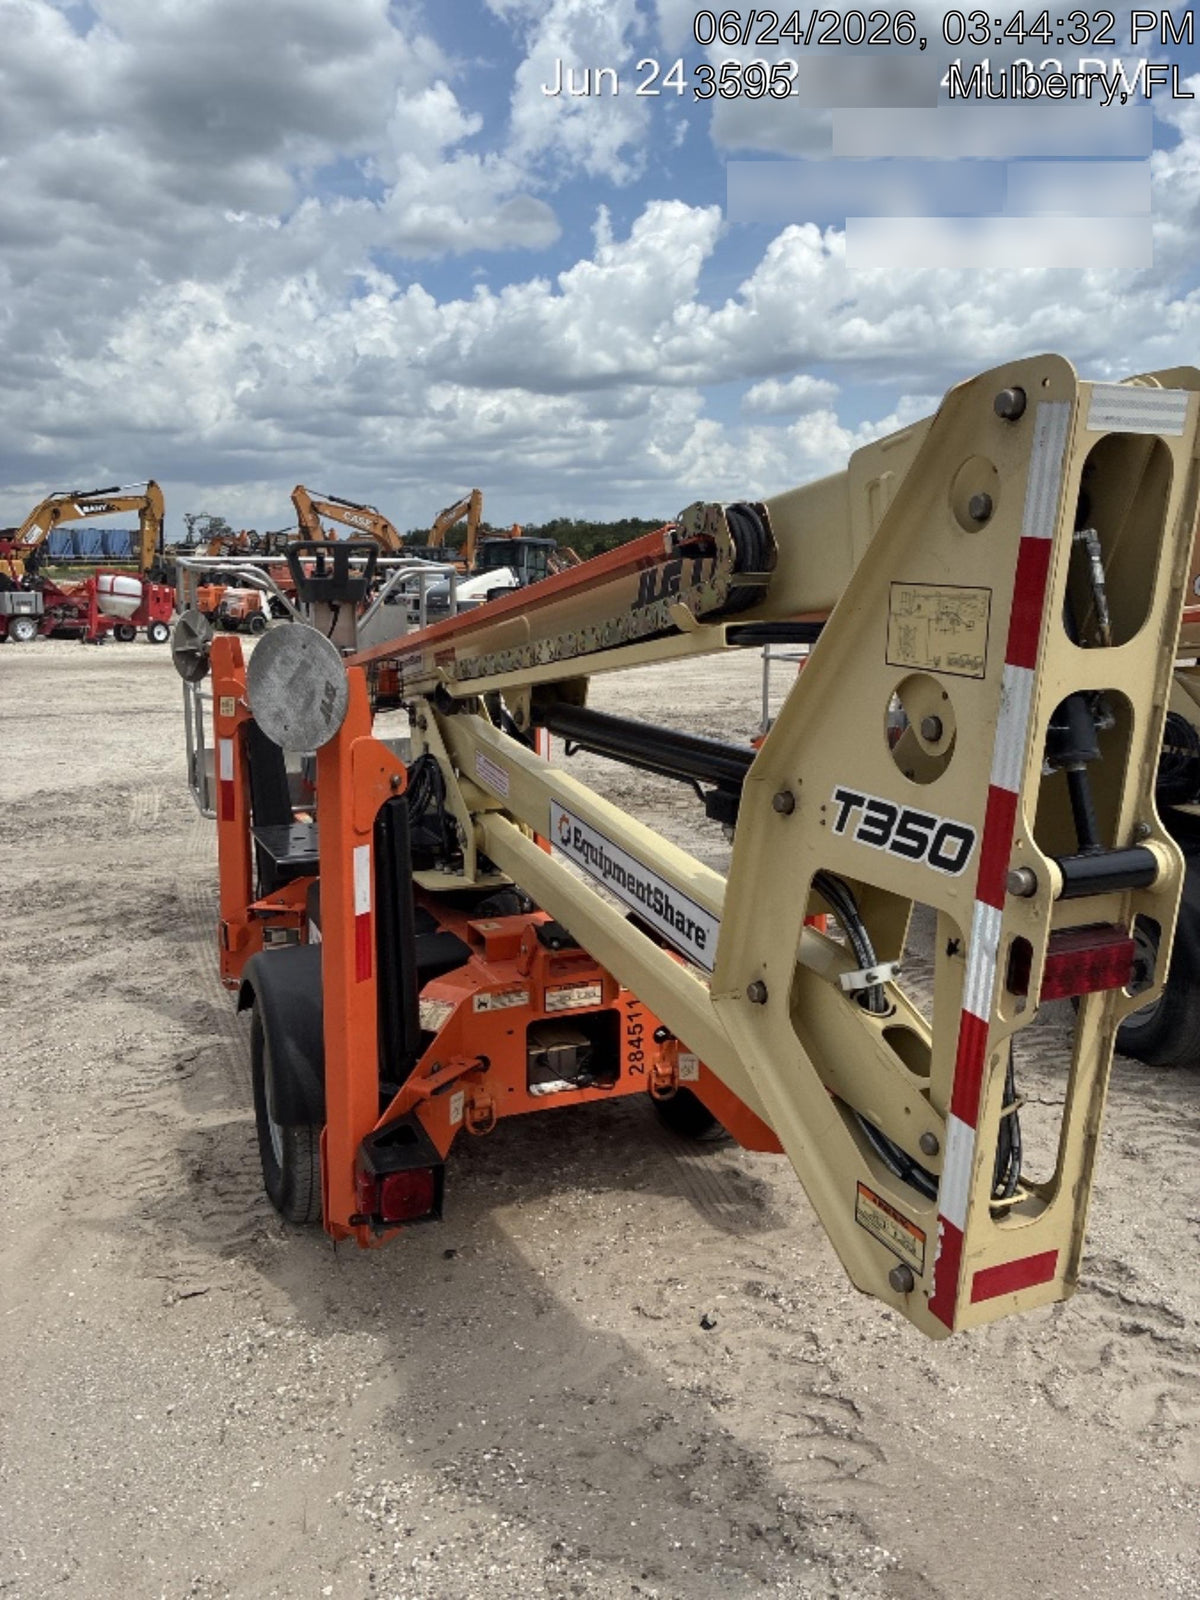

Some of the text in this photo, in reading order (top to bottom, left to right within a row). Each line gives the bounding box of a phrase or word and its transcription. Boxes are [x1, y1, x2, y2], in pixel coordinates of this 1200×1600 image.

[833, 787, 976, 875] T350
[573, 826, 707, 950] EquipmentShare
[625, 1000, 645, 1077] 284511
